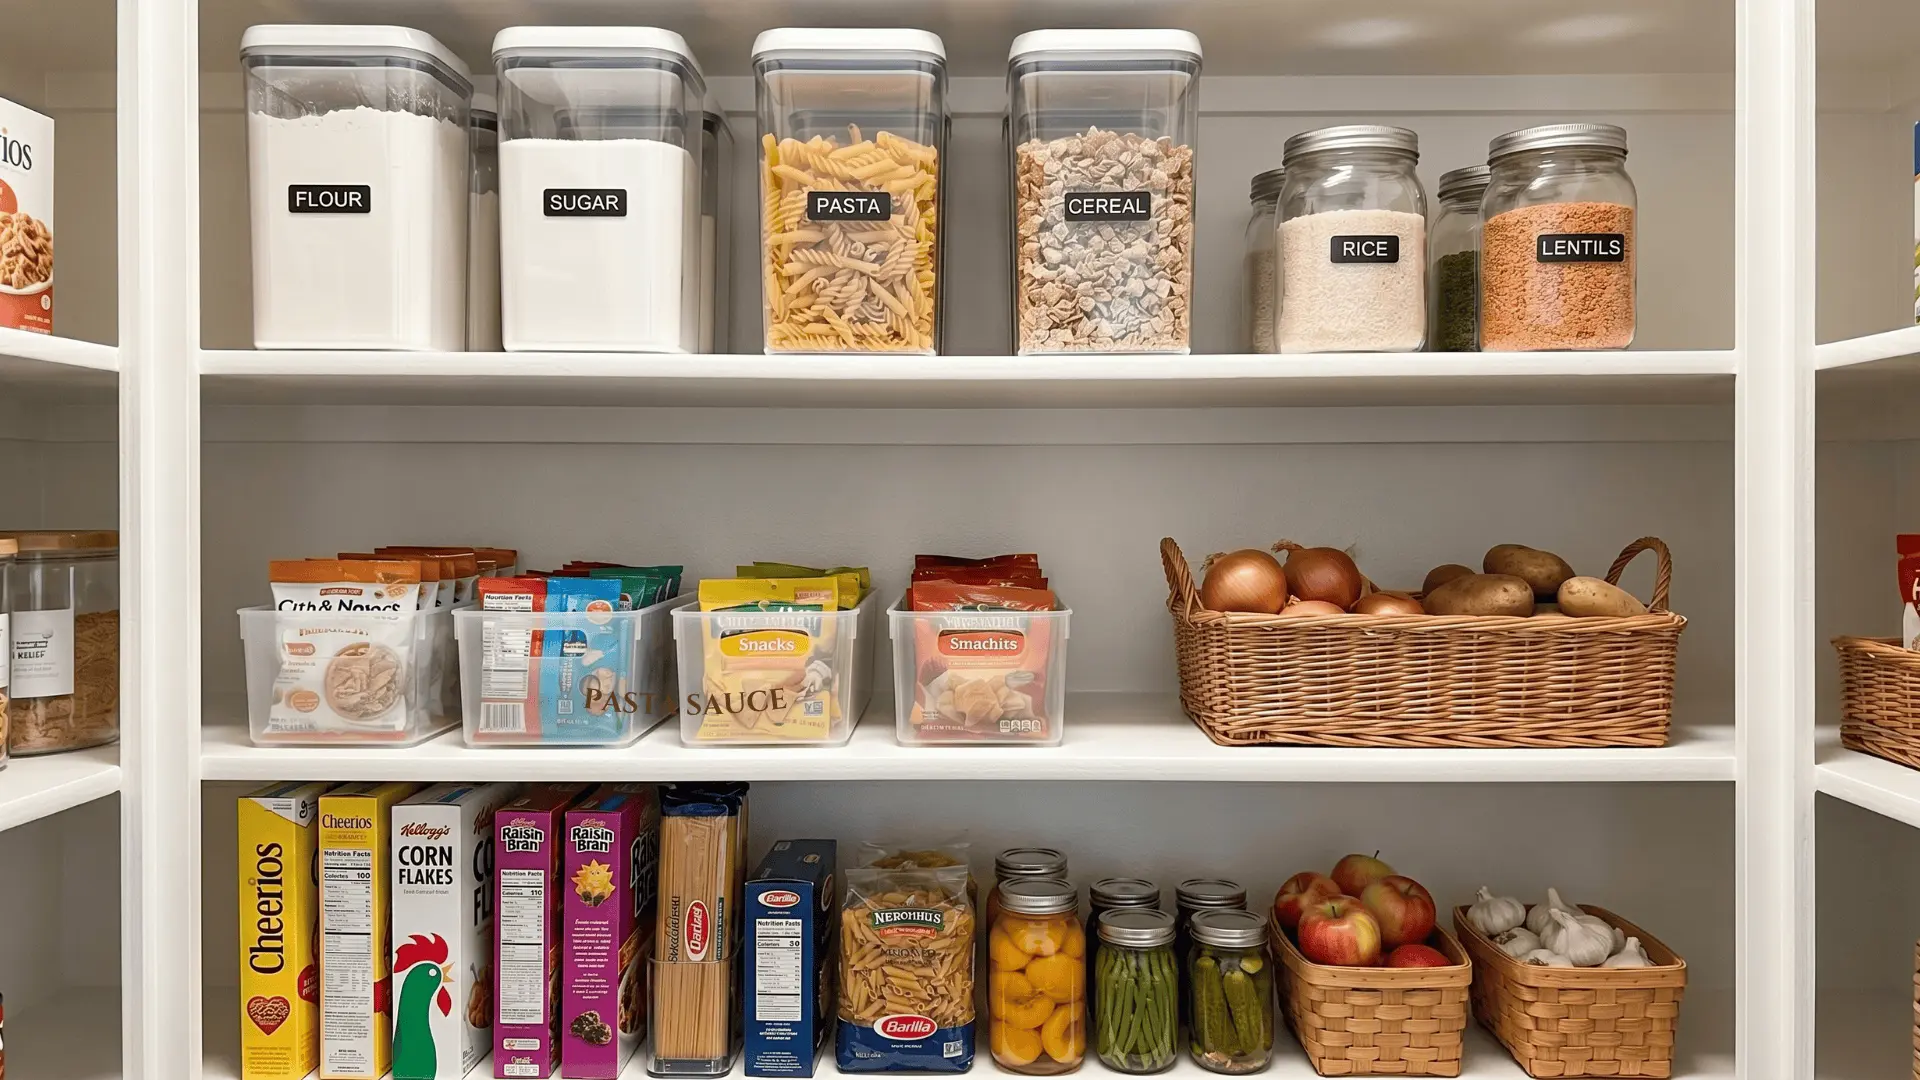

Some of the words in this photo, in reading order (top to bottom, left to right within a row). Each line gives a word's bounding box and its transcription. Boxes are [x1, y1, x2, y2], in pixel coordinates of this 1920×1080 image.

[0, 127, 32, 170] ios
[295, 191, 363, 208] FLOUR
[549, 195, 619, 211] SUGAR
[816, 198, 881, 214] PASTA
[1067, 197, 1147, 214] CEREAL
[1342, 241, 1388, 257] RICE
[1542, 240, 1621, 256] LENTILS
[739, 637, 795, 651] Snacks
[950, 637, 1018, 650] Smachits
[322, 814, 372, 829] Cheerios
[400, 822, 451, 840] Kellogg's
[502, 826, 543, 841] Raisin
[572, 826, 613, 841] Raisin
[507, 839, 538, 851] Bran
[577, 840, 608, 852] Bran
[398, 845, 453, 866] CORN
[398, 868, 454, 885] FLAKES
[248, 842, 284, 974] Cheerios
[886, 1020, 931, 1034] Barilla
